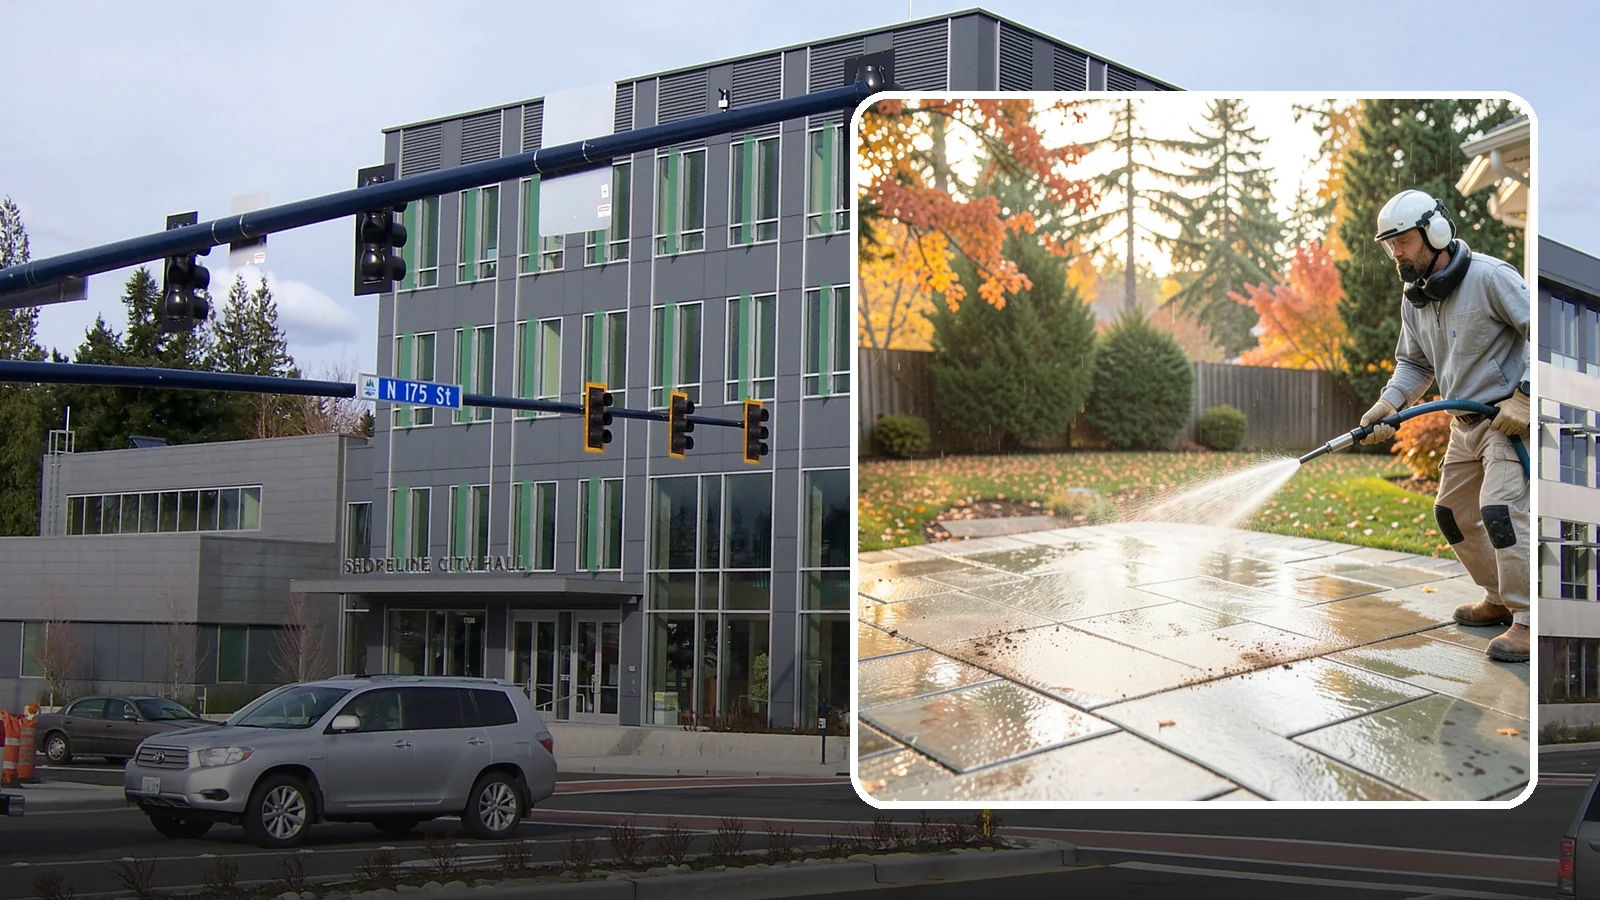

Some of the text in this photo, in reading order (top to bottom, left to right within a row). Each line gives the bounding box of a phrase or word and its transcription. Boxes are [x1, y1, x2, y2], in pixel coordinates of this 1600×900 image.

[387, 380, 451, 406] N 175 St
[344, 555, 525, 574] SHORELINE CITY HALL
